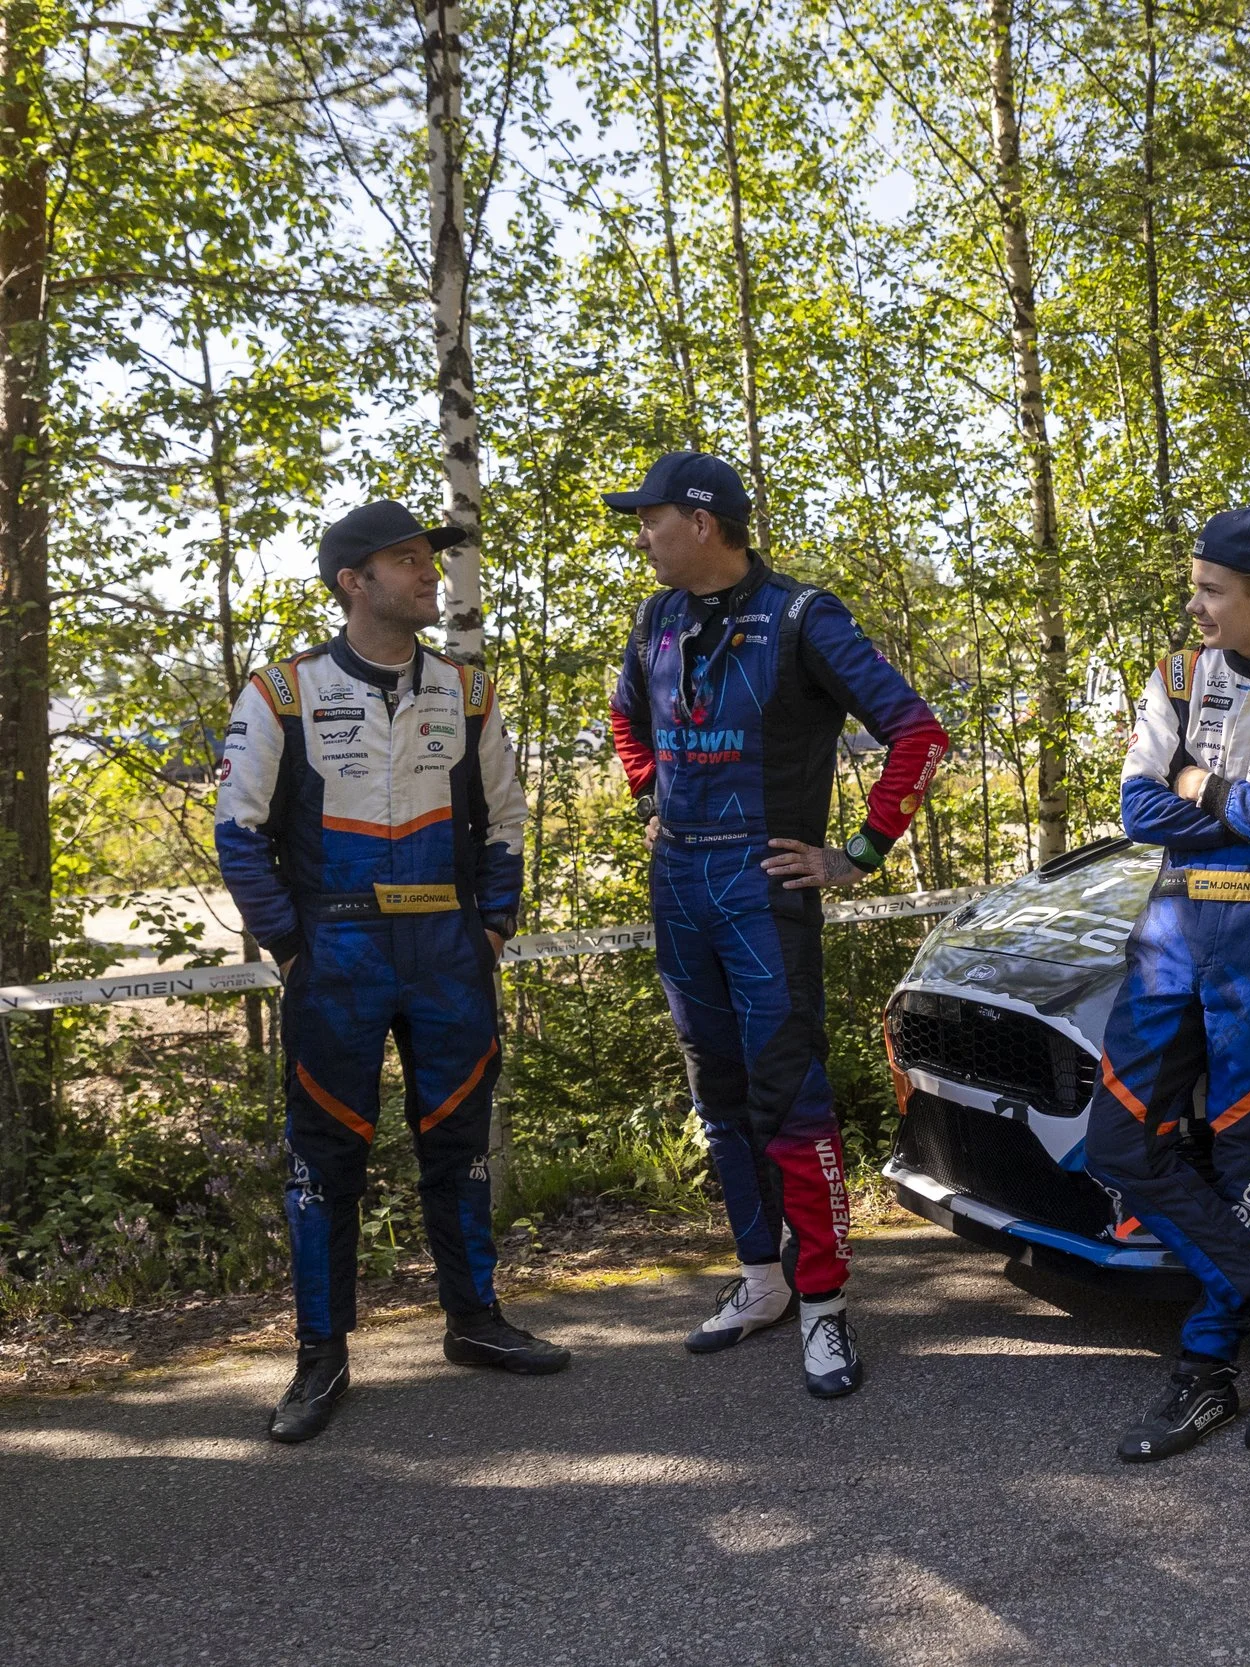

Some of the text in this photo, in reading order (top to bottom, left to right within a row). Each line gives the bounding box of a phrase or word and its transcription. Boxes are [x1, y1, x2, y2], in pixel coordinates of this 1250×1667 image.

[267, 667, 293, 705] sparco
[1172, 654, 1184, 691] sparco
[322, 752, 368, 761] HYRMASKINER
[403, 894, 450, 903] J.GRÖNVALL
[1194, 1404, 1224, 1432] sparco
